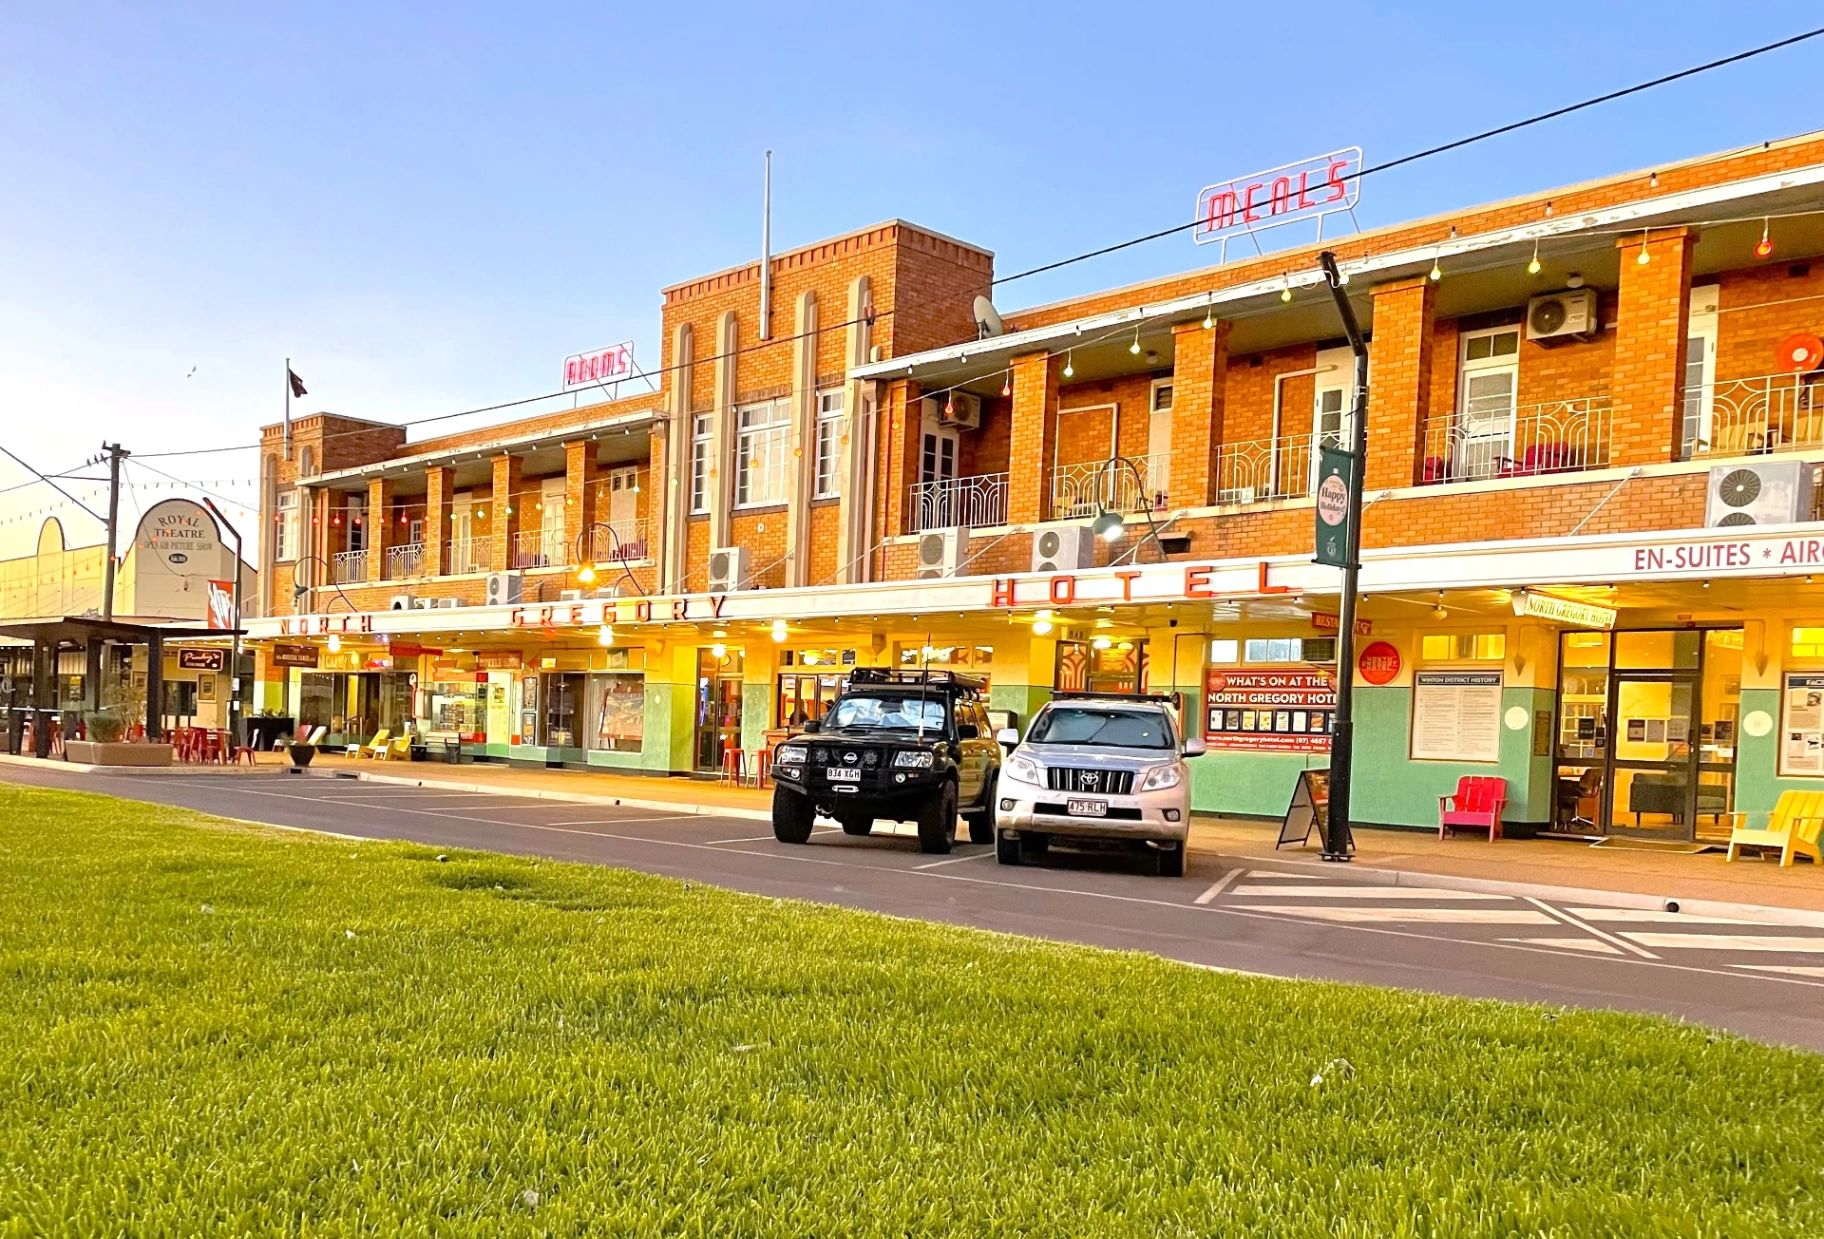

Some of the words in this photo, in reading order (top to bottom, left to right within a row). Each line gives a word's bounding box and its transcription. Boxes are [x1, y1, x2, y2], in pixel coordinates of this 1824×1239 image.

[1207, 160, 1348, 232] MEALS
[567, 348, 627, 386] ROOMS
[1322, 487, 1346, 504] Happy
[158, 515, 200, 528] ROYAL
[154, 528, 205, 538] THEATRE
[1634, 543, 1751, 571] EN-SUITES
[1780, 540, 1824, 564] AIR
[280, 615, 373, 635] NORTH
[511, 595, 726, 627] GREGORY
[991, 561, 1288, 608] HOTEL
[1527, 597, 1556, 615] NORTH
[1556, 604, 1589, 621] GREGORY
[1226, 676, 1267, 687] WHAT'S
[1268, 676, 1287, 687] ON
[1288, 676, 1304, 687] AT
[1305, 676, 1328, 687] THE
[1207, 692, 1247, 703] NORTH
[1248, 693, 1305, 704] GREGORY
[1307, 693, 1337, 704] HOTE
